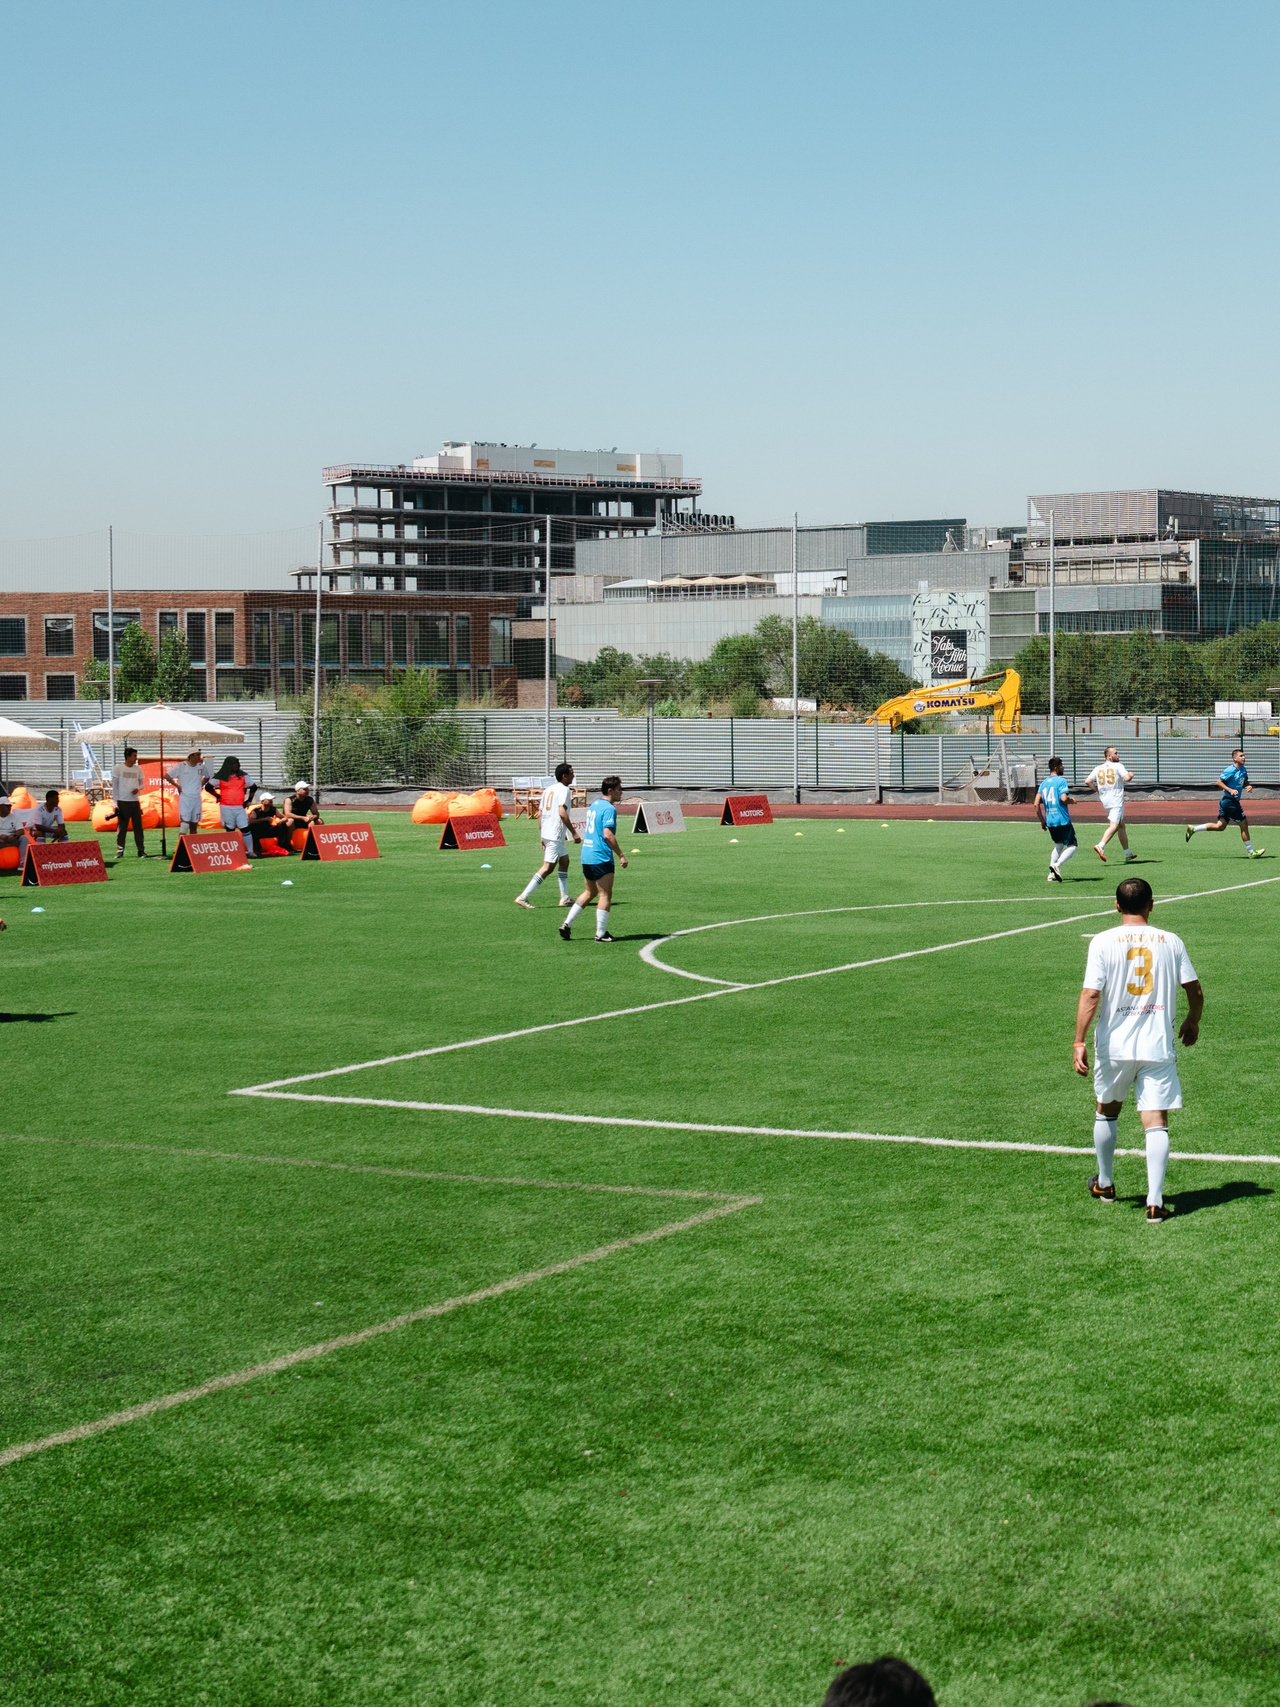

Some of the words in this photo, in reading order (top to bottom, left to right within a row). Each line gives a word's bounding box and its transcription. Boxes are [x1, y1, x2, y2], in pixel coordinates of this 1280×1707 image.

[931, 636, 955, 656] Saks
[943, 648, 967, 665] Fifth
[930, 657, 964, 675] Avenue
[927, 696, 975, 708] KOMATSU
[1097, 768, 1116, 786] 99
[1042, 786, 1057, 805] 14
[740, 809, 765, 818] MOTORS
[319, 832, 350, 844] SUPER
[350, 831, 370, 842] CUP
[465, 830, 495, 840] MOTORS
[191, 842, 221, 855] SUPER
[220, 840, 239, 853] CUP
[335, 843, 361, 855] 2026
[207, 854, 233, 867] 2026
[1126, 947, 1154, 996] 3
[1116, 1005, 1139, 1013] ASTANA
